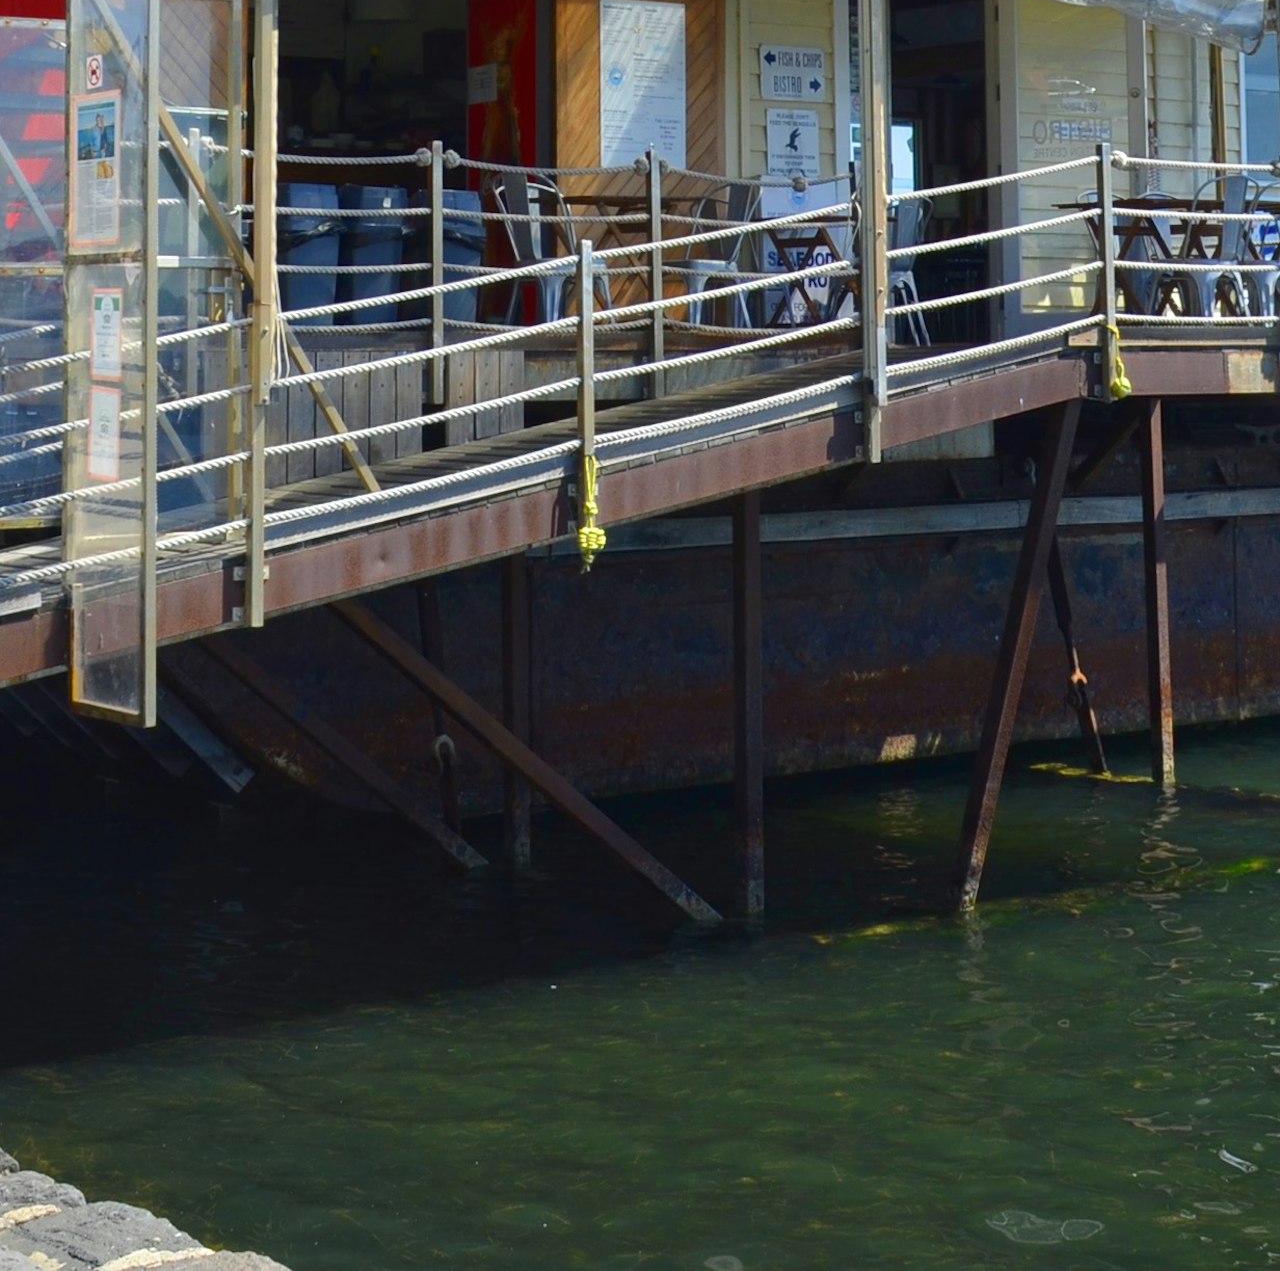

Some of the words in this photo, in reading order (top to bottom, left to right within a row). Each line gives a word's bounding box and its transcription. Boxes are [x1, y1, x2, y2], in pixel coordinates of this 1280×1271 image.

[778, 51, 793, 67] FISH
[795, 52, 801, 67] &
[803, 54, 823, 69] CHIPS
[773, 76, 803, 93] BISTRO
